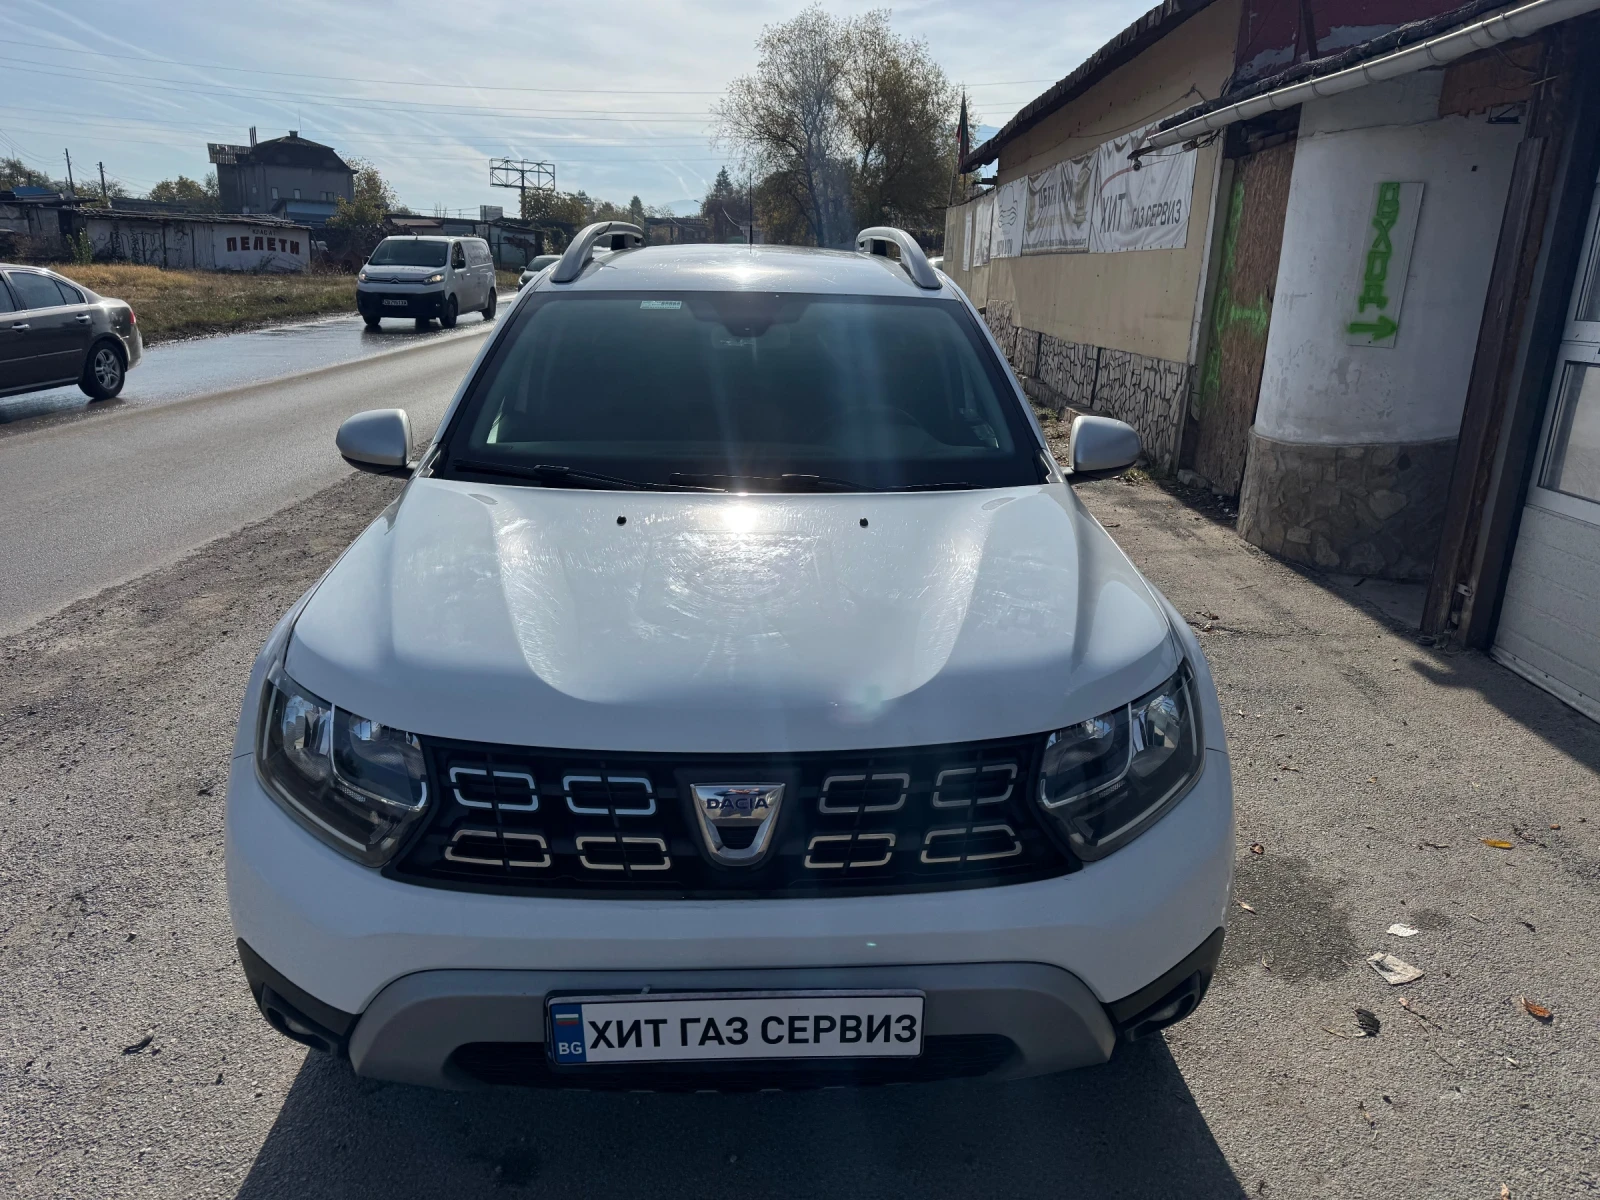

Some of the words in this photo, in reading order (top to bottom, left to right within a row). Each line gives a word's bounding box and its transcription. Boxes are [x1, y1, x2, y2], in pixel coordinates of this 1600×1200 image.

[1099, 193, 1126, 233] ХИТ
[1130, 206, 1145, 230] ГАЗ
[1145, 199, 1182, 228] СЕРВИЗ
[226, 236, 300, 255] ПЕЛЕТИ
[706, 798, 769, 809] DACIA
[589, 1019, 668, 1049] ХИТ
[679, 1017, 749, 1046] ГАЗ
[760, 1014, 918, 1045] СЕРВИЗ
[558, 1041, 583, 1055] BG
